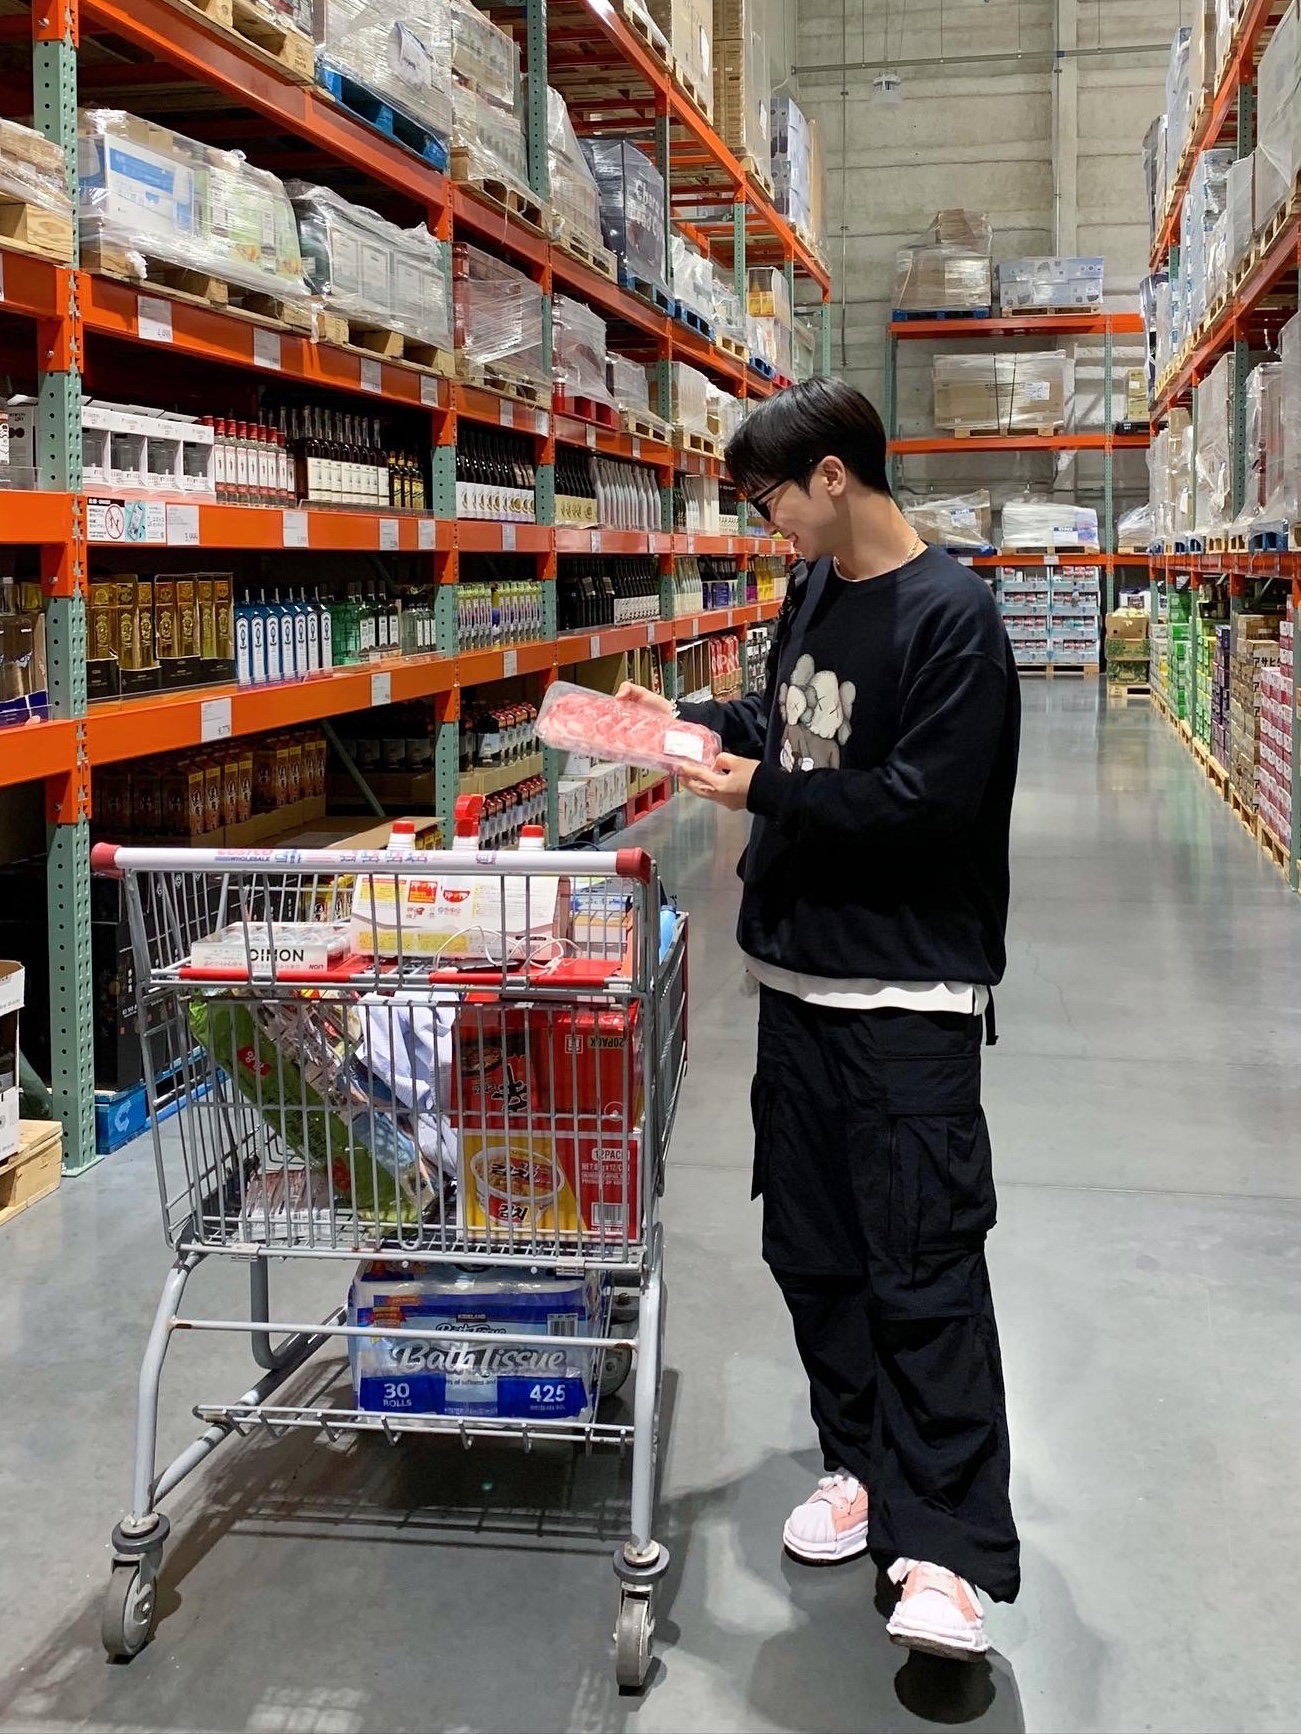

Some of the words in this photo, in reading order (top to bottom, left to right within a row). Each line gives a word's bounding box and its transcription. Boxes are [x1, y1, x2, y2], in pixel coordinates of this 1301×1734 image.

[392, 1339, 477, 1374] Bath
[478, 1343, 566, 1376] Tissue
[384, 1382, 410, 1399] 30
[530, 1384, 566, 1403] 425
[382, 1398, 412, 1407] ROLLS
